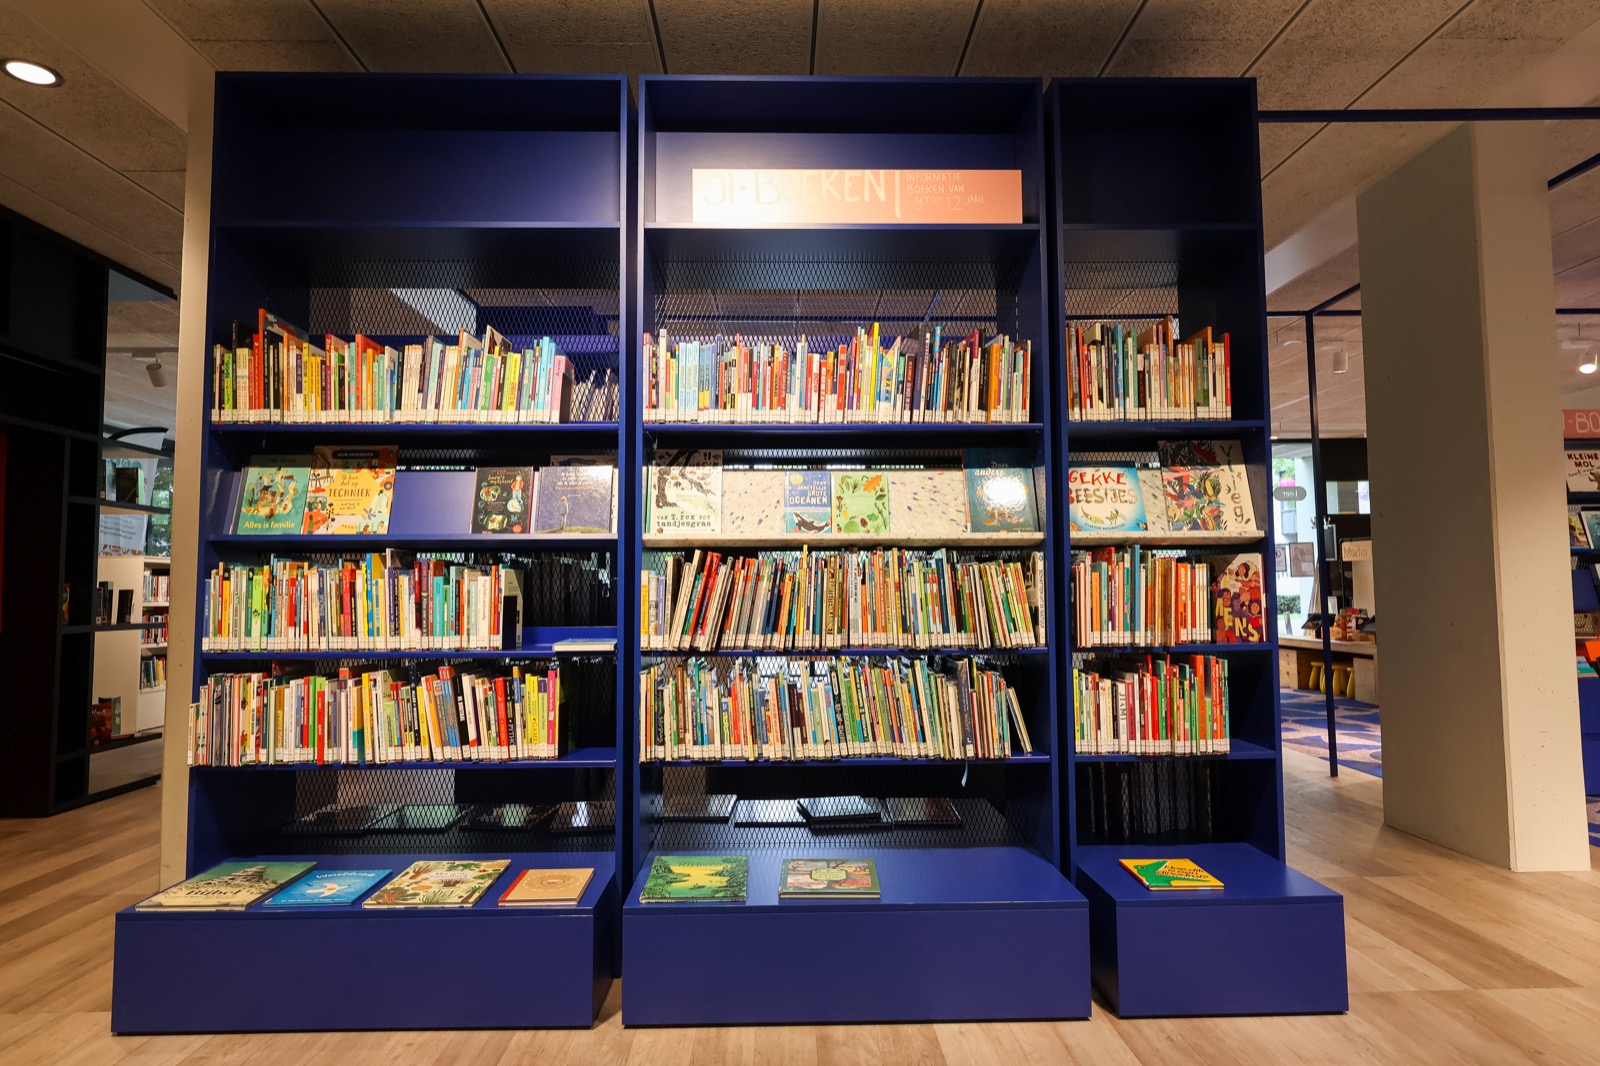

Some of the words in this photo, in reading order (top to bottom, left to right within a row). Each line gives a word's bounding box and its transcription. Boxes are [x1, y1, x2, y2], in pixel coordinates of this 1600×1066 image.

[906, 172, 962, 182] INFORMATIE
[907, 184, 946, 194] BOEKEN
[949, 184, 965, 193] VAN
[915, 196, 923, 211] 9
[924, 196, 944, 204] TOT
[946, 196, 962, 212] 12
[964, 195, 984, 205] JAAR
[1069, 470, 1126, 486] GEKKE
[329, 488, 370, 498] TECHNIEK
[789, 496, 828, 505] OCEANEN
[243, 521, 262, 529] Alles
[270, 521, 295, 529] familie
[1343, 546, 1368, 560] Media
